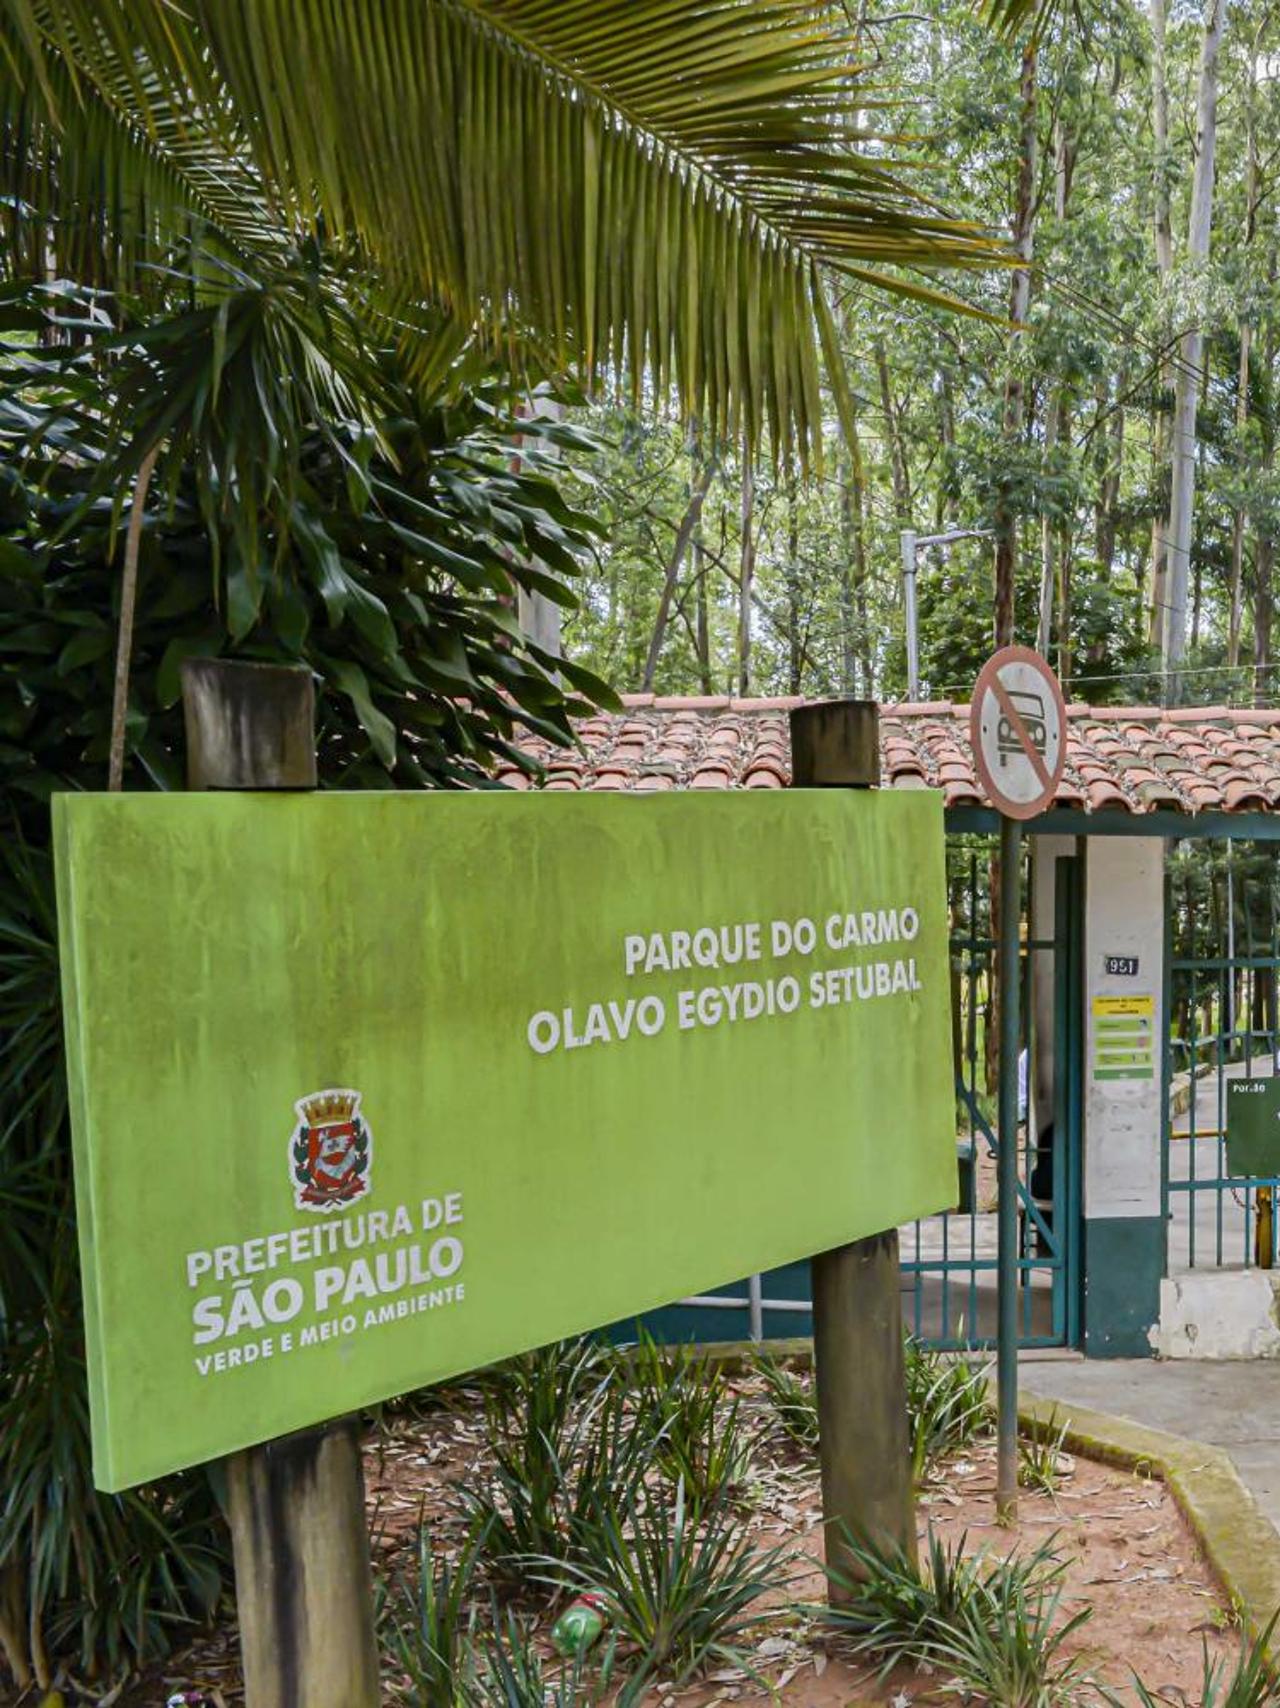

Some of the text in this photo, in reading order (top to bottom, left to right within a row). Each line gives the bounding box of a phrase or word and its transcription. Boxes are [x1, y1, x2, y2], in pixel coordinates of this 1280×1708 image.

[625, 906, 919, 976] PARQUE DO CARMO
[1110, 959, 1133, 974] 951
[527, 958, 922, 1054] OLAVO EGYDIO SETUBAL
[186, 1192, 464, 1288] PREFEITURA DE
[193, 1236, 464, 1346] SÃO PAULO
[195, 1283, 465, 1376] VERDE E MEIO AMBIENTE
